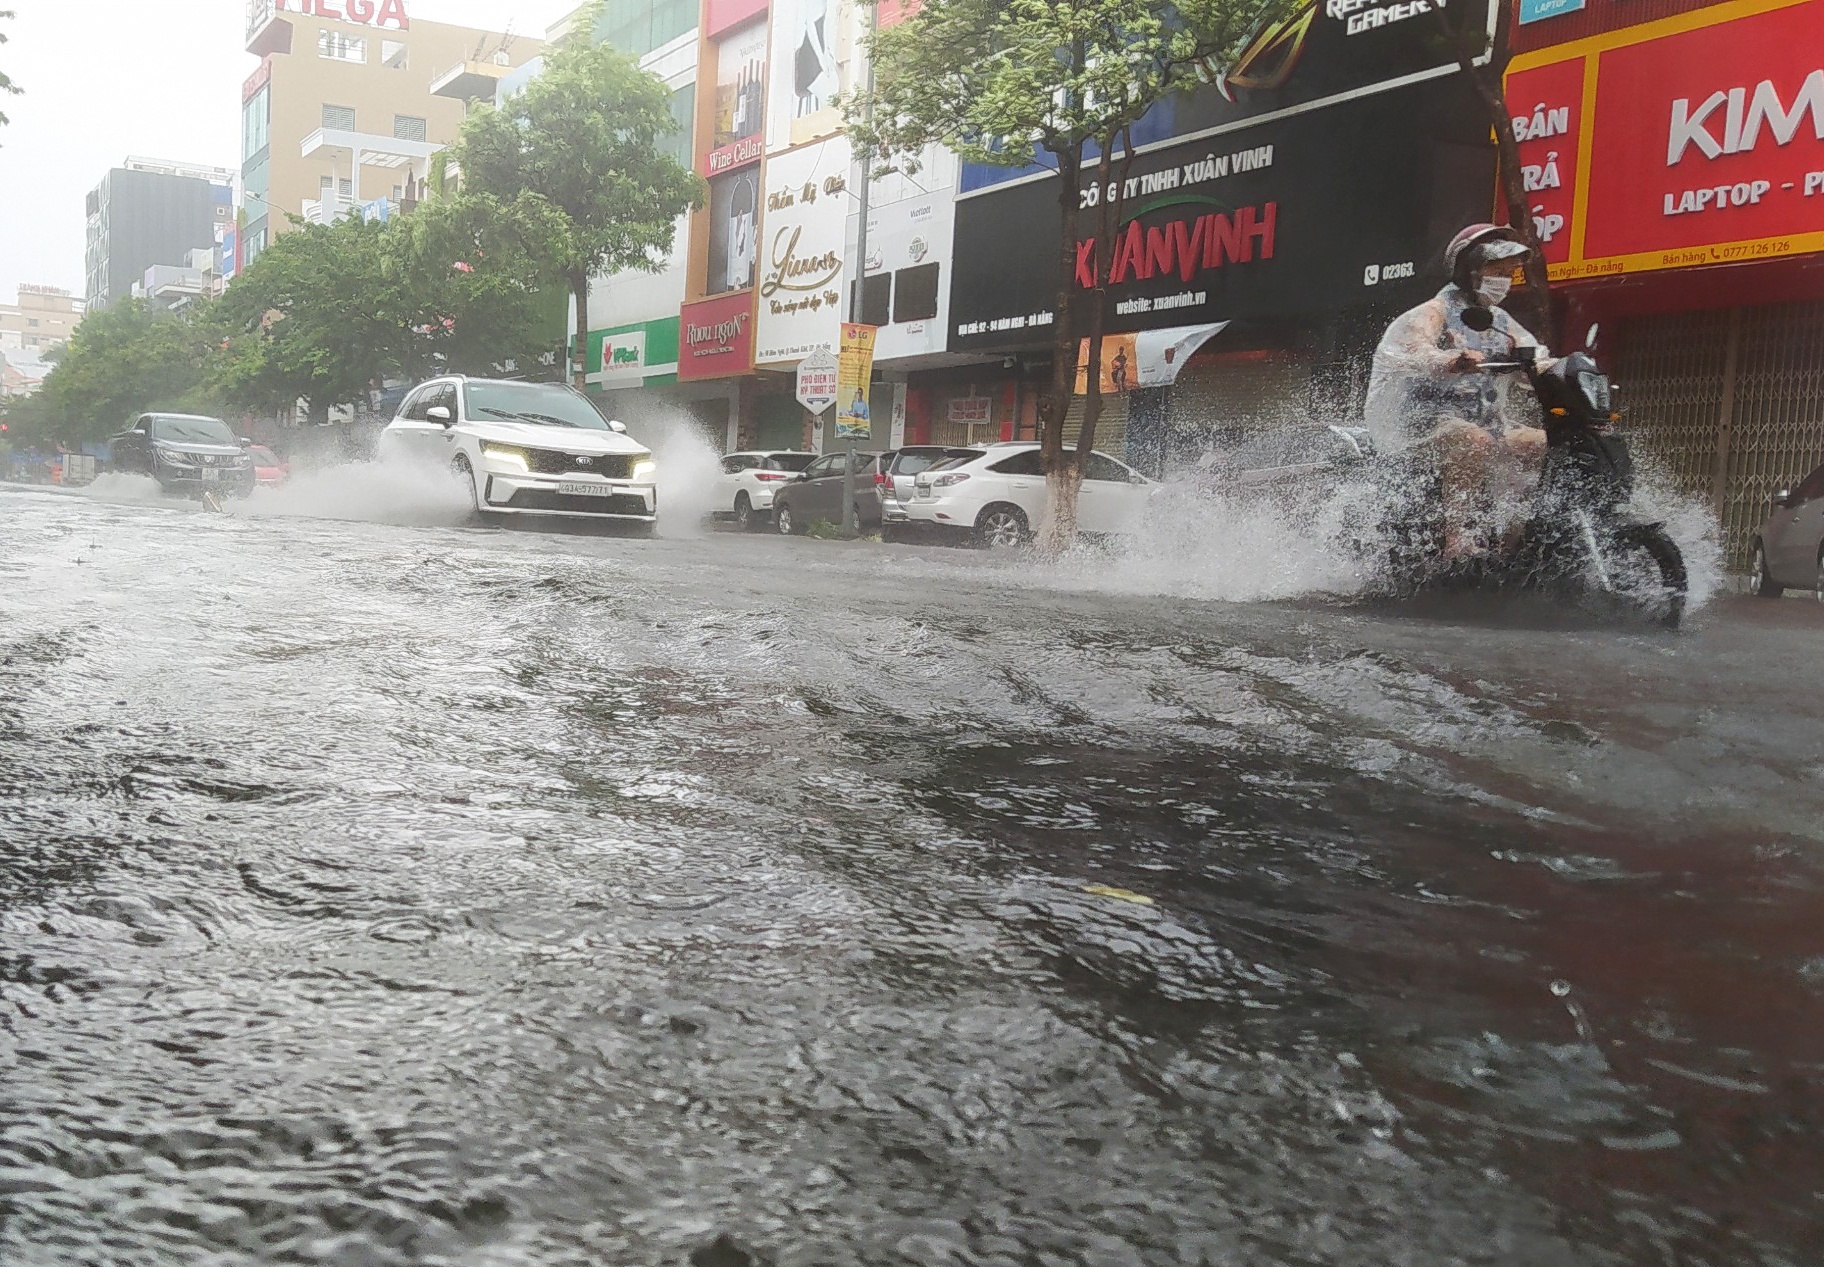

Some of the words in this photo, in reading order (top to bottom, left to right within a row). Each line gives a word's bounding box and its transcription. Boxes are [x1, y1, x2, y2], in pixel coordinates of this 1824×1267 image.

[276, 0, 410, 30] EGA
[1512, 102, 1569, 143] BÁN
[1667, 69, 1824, 167] KIM
[709, 152, 731, 172] Wine
[734, 140, 762, 163] Cellar
[1521, 151, 1561, 192] RẢ
[1079, 181, 1118, 209] CÔG
[1142, 168, 1180, 195] TNHH
[1182, 153, 1229, 186] XUÂN
[1232, 145, 1274, 174] VINH
[1663, 180, 1771, 216] LAPTOP
[1662, 253, 1680, 264] Bán
[1724, 245, 1749, 258] 0777
[1751, 243, 1768, 255] 126
[1772, 241, 1790, 253] 126
[1116, 297, 1151, 316] website:
[1153, 290, 1206, 310] xuanvinh.vn
[858, 330, 868, 339] LG
